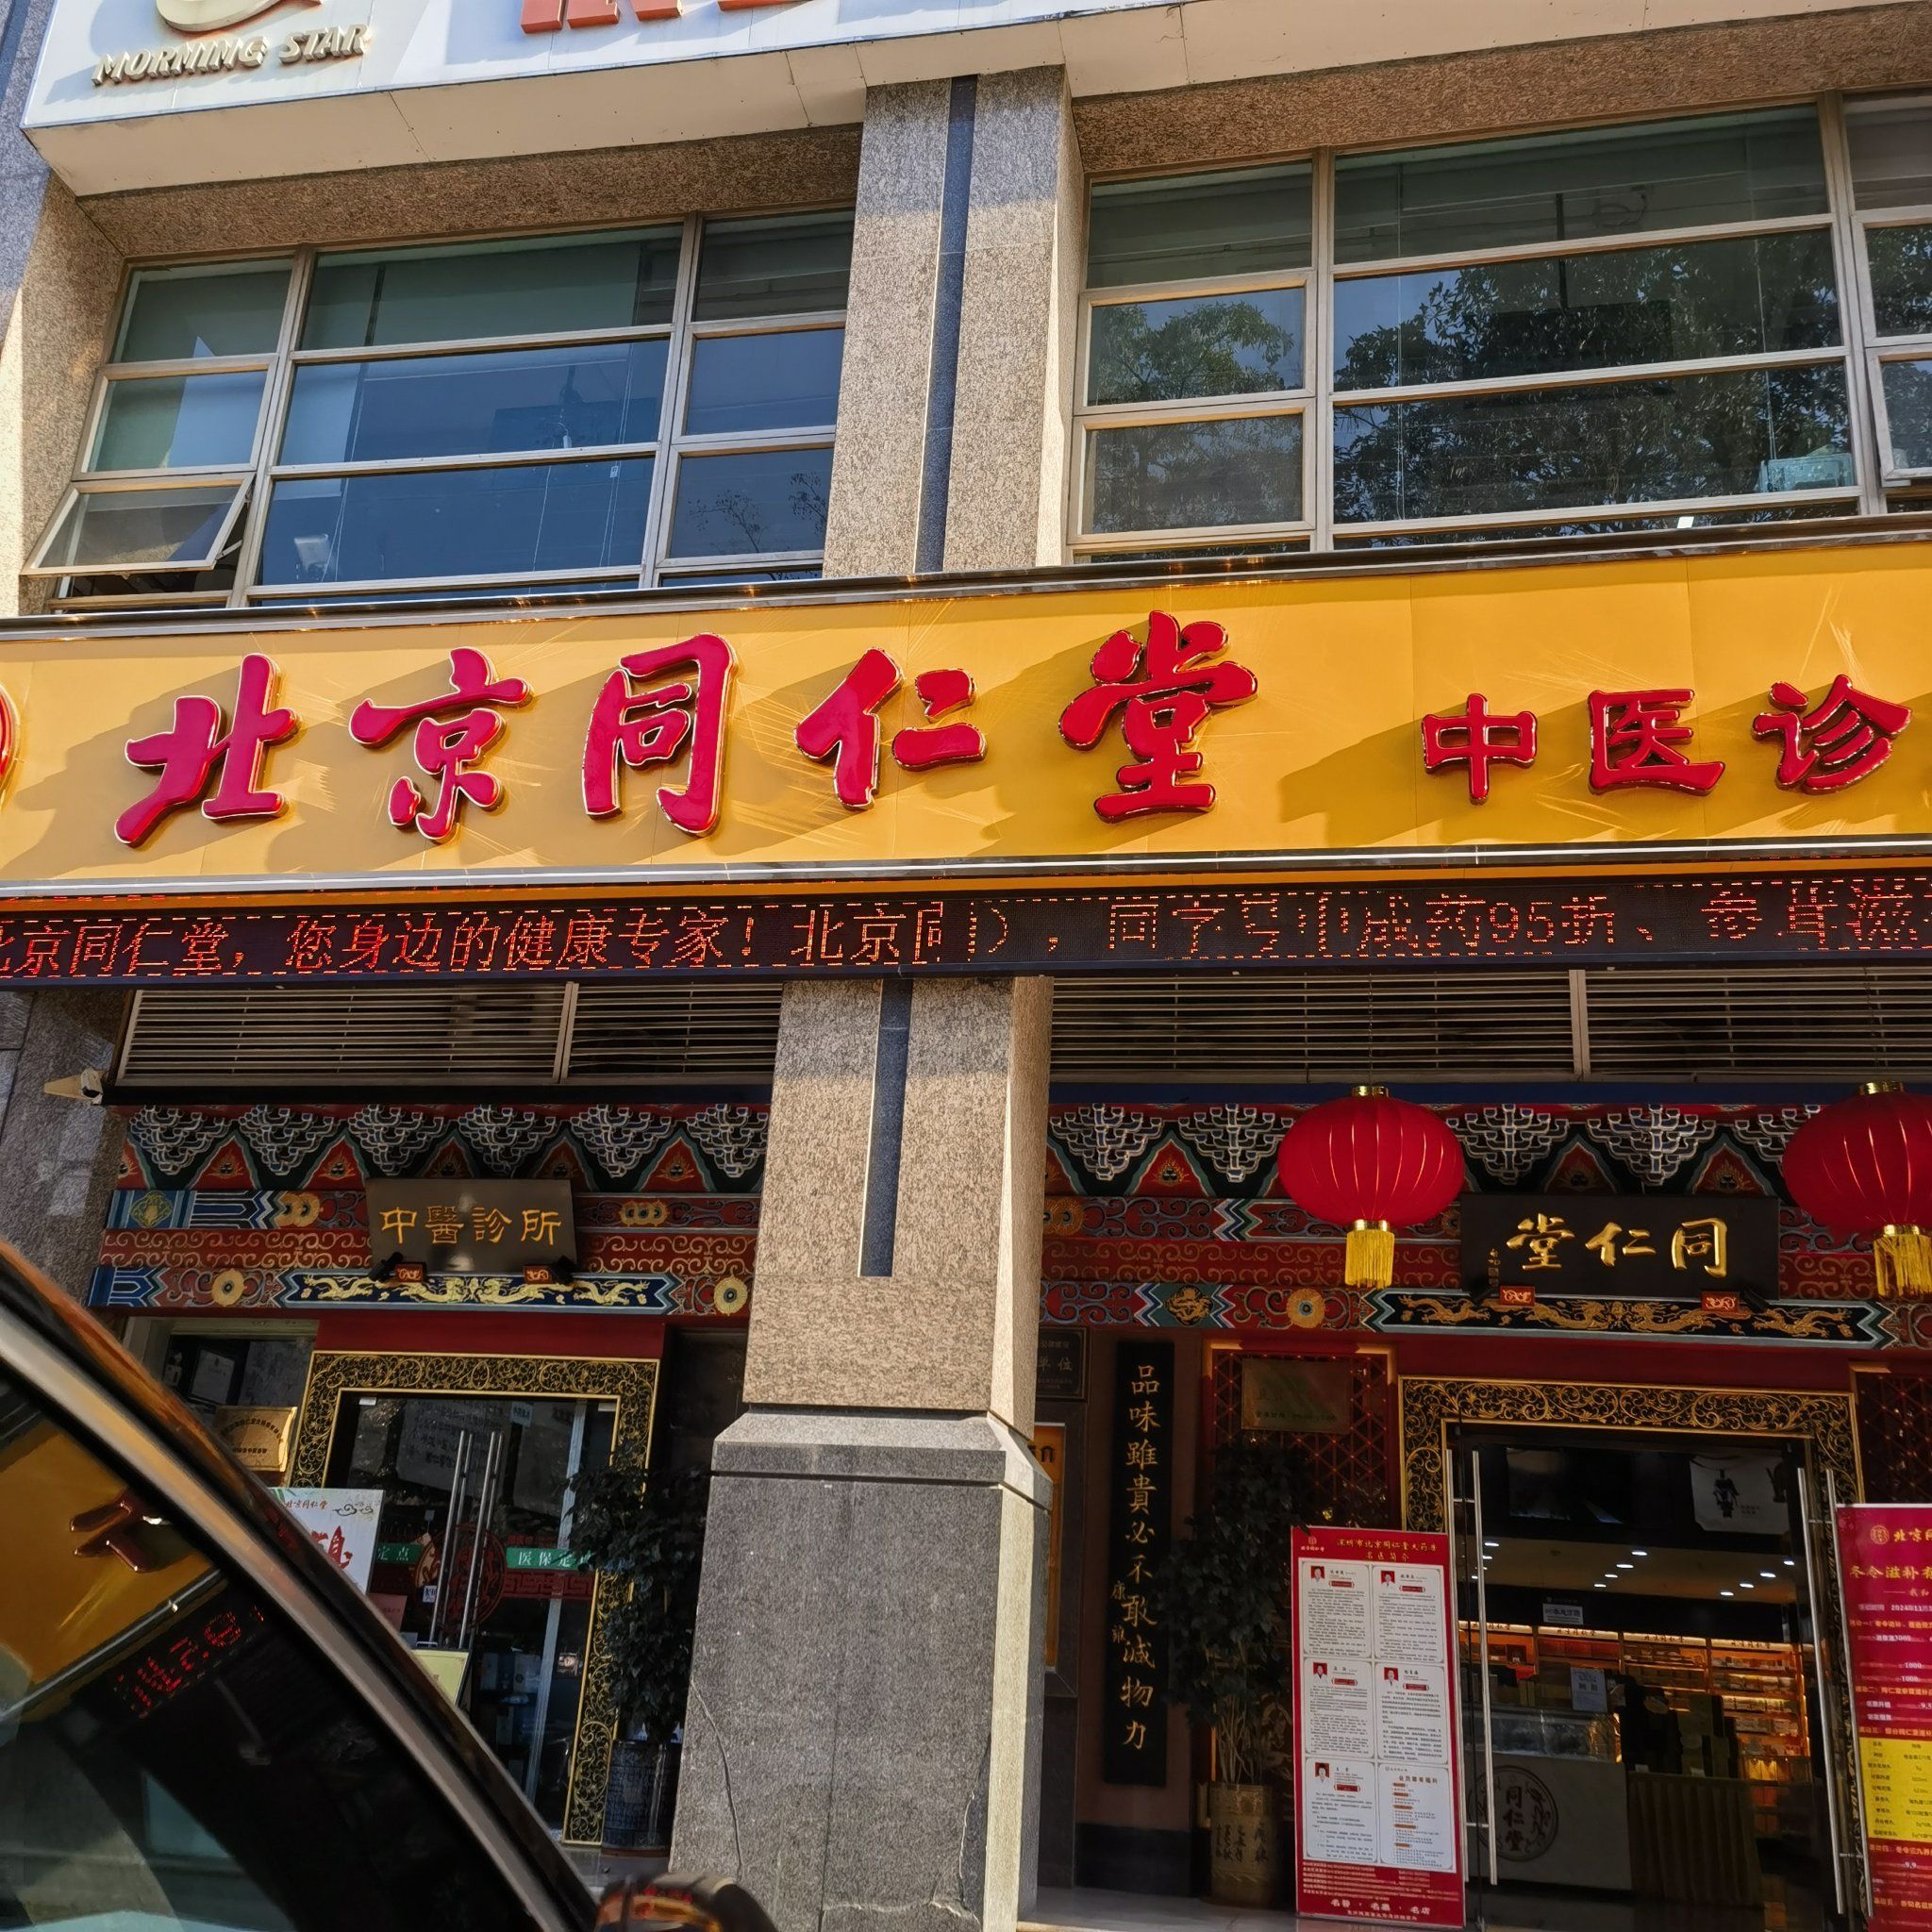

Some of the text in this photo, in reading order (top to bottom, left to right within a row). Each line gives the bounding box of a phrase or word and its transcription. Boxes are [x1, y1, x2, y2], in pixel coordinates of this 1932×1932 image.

[92, 24, 370, 86] MORNING STAR
[114, 609, 1913, 847] 北京同仁堂 中医诊
[379, 1206, 561, 1245] 中醫診所
